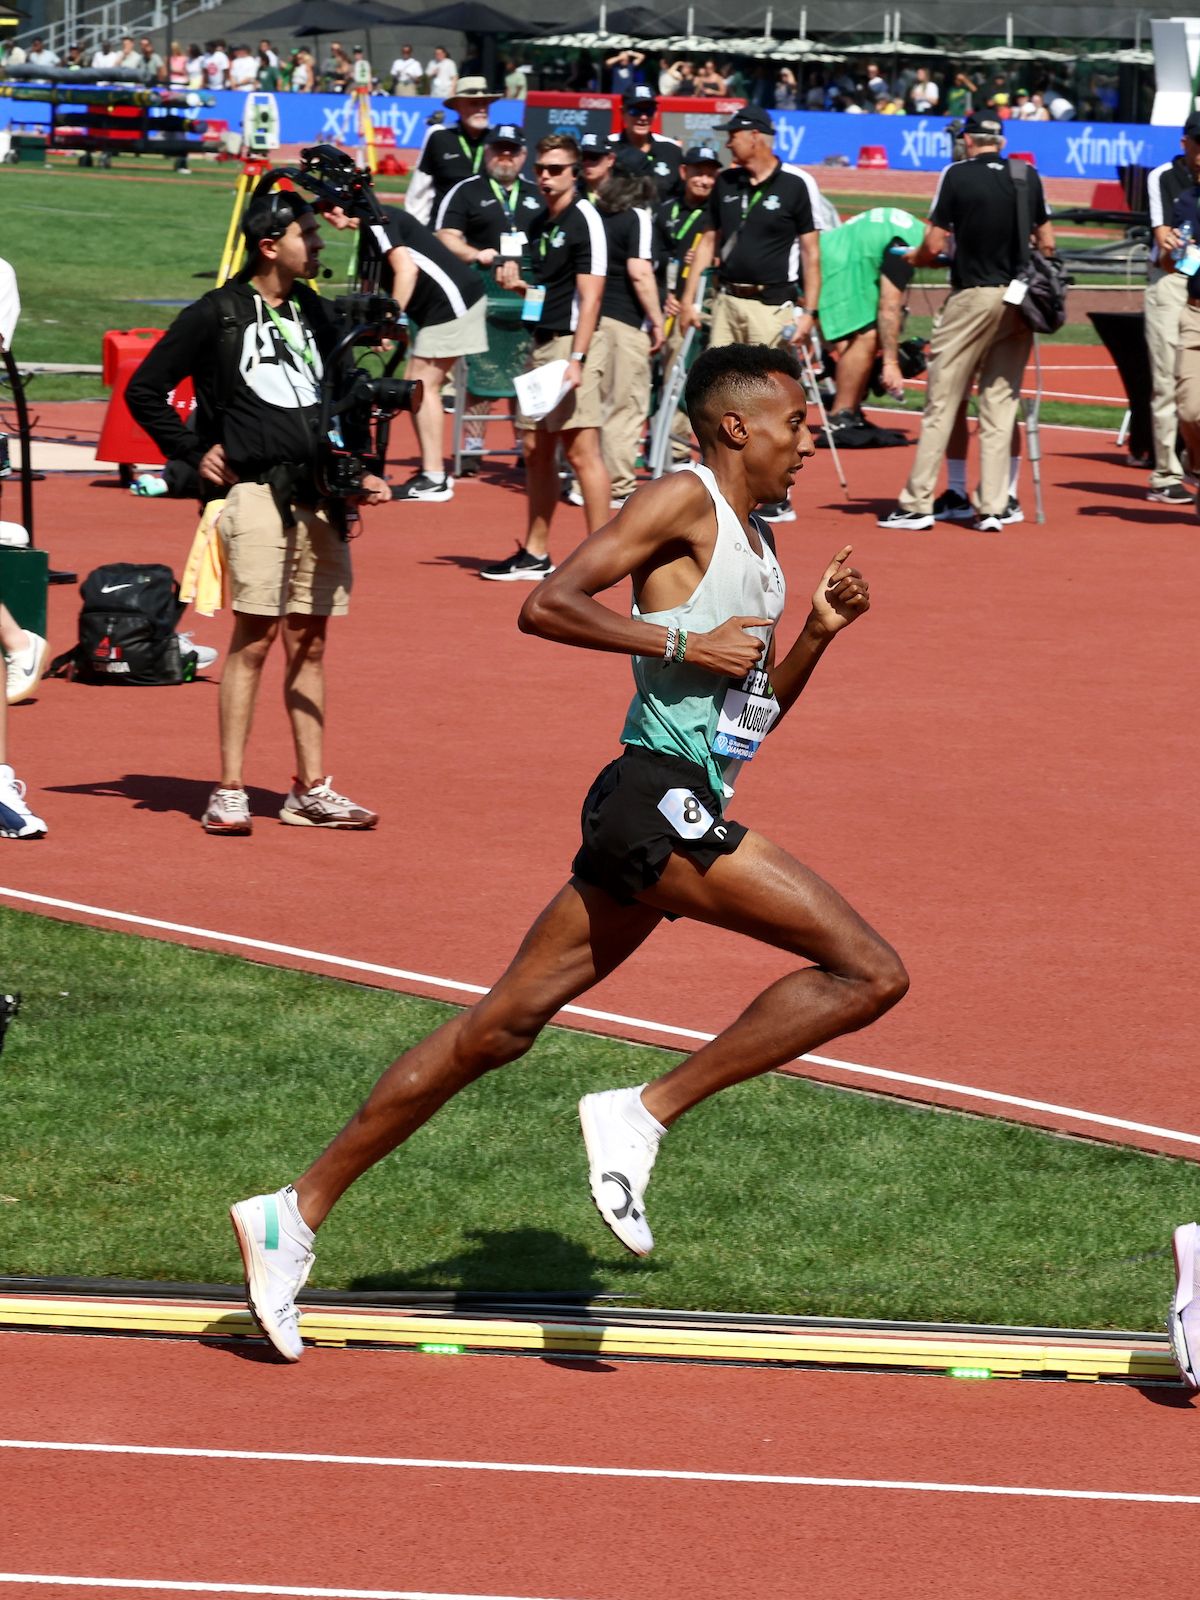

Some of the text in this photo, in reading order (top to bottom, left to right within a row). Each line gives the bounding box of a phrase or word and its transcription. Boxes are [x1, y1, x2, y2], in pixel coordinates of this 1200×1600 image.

[548, 109, 588, 125] EUGENE
[741, 669, 769, 696] PRE
[683, 796, 702, 824] 8
